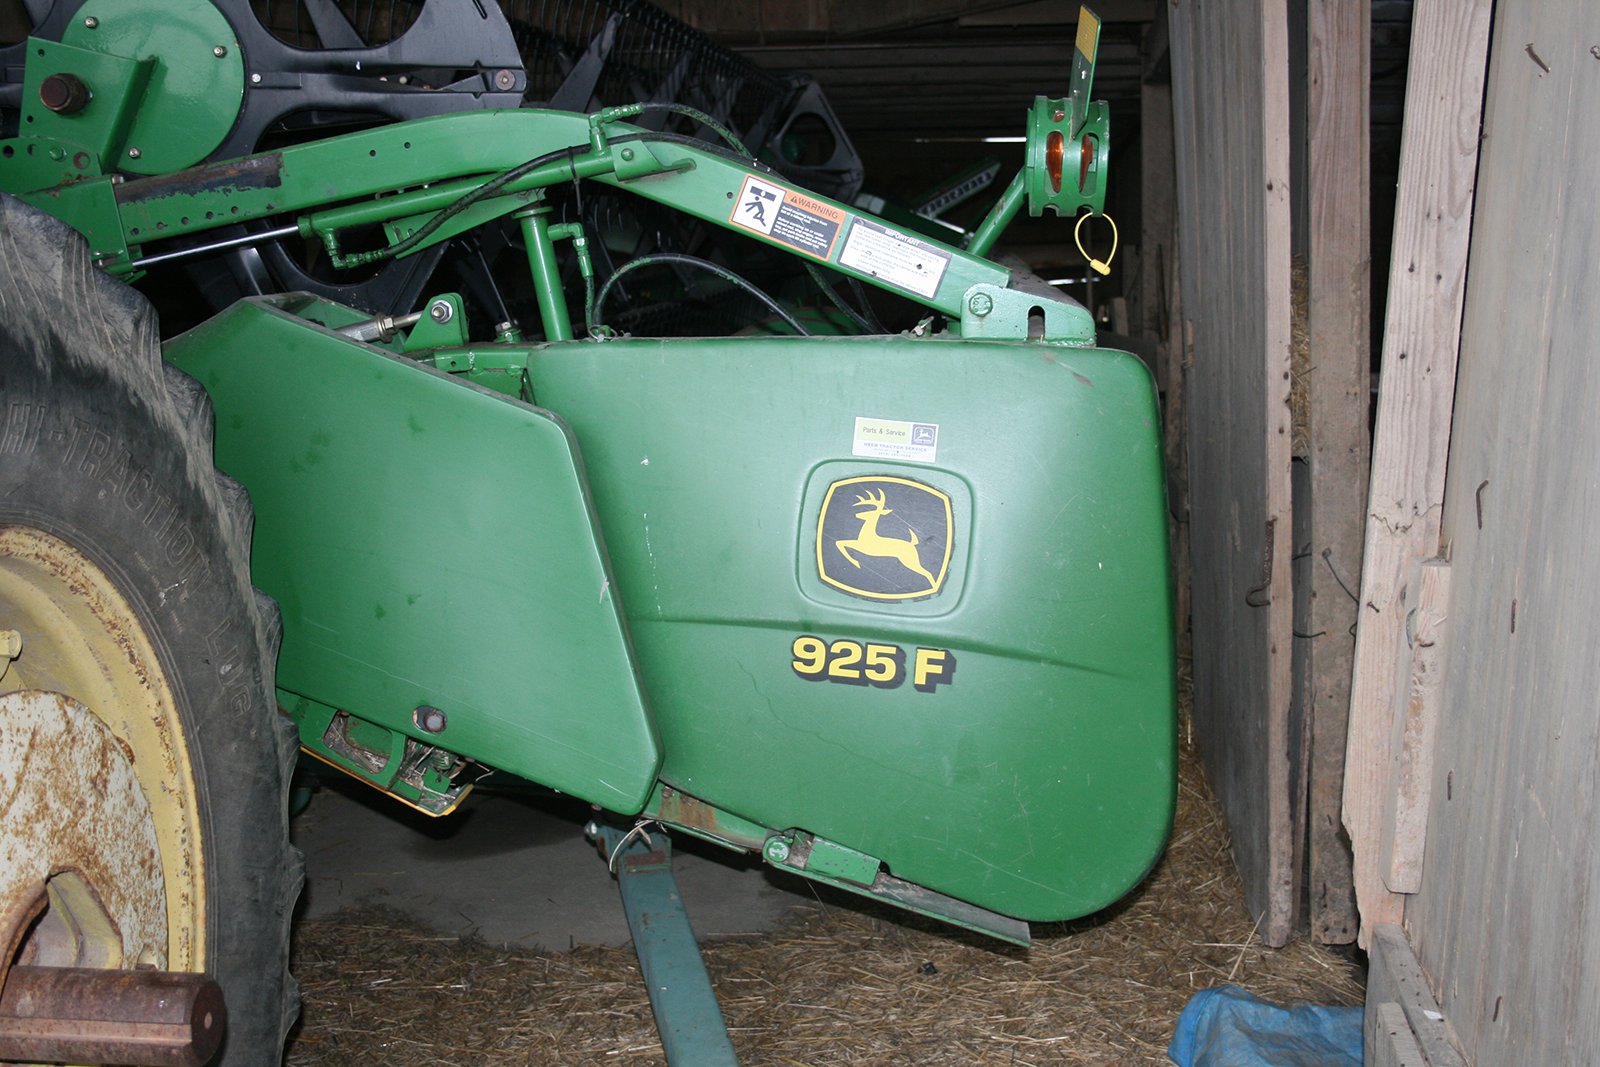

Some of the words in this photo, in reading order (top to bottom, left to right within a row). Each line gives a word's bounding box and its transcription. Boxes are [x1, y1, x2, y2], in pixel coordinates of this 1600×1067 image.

[798, 197, 838, 220] WARNING
[884, 228, 920, 247] IMPORTANT
[862, 426, 877, 434] Parts
[885, 428, 906, 437] Service
[791, 635, 902, 686] 925
[913, 648, 950, 688] F
